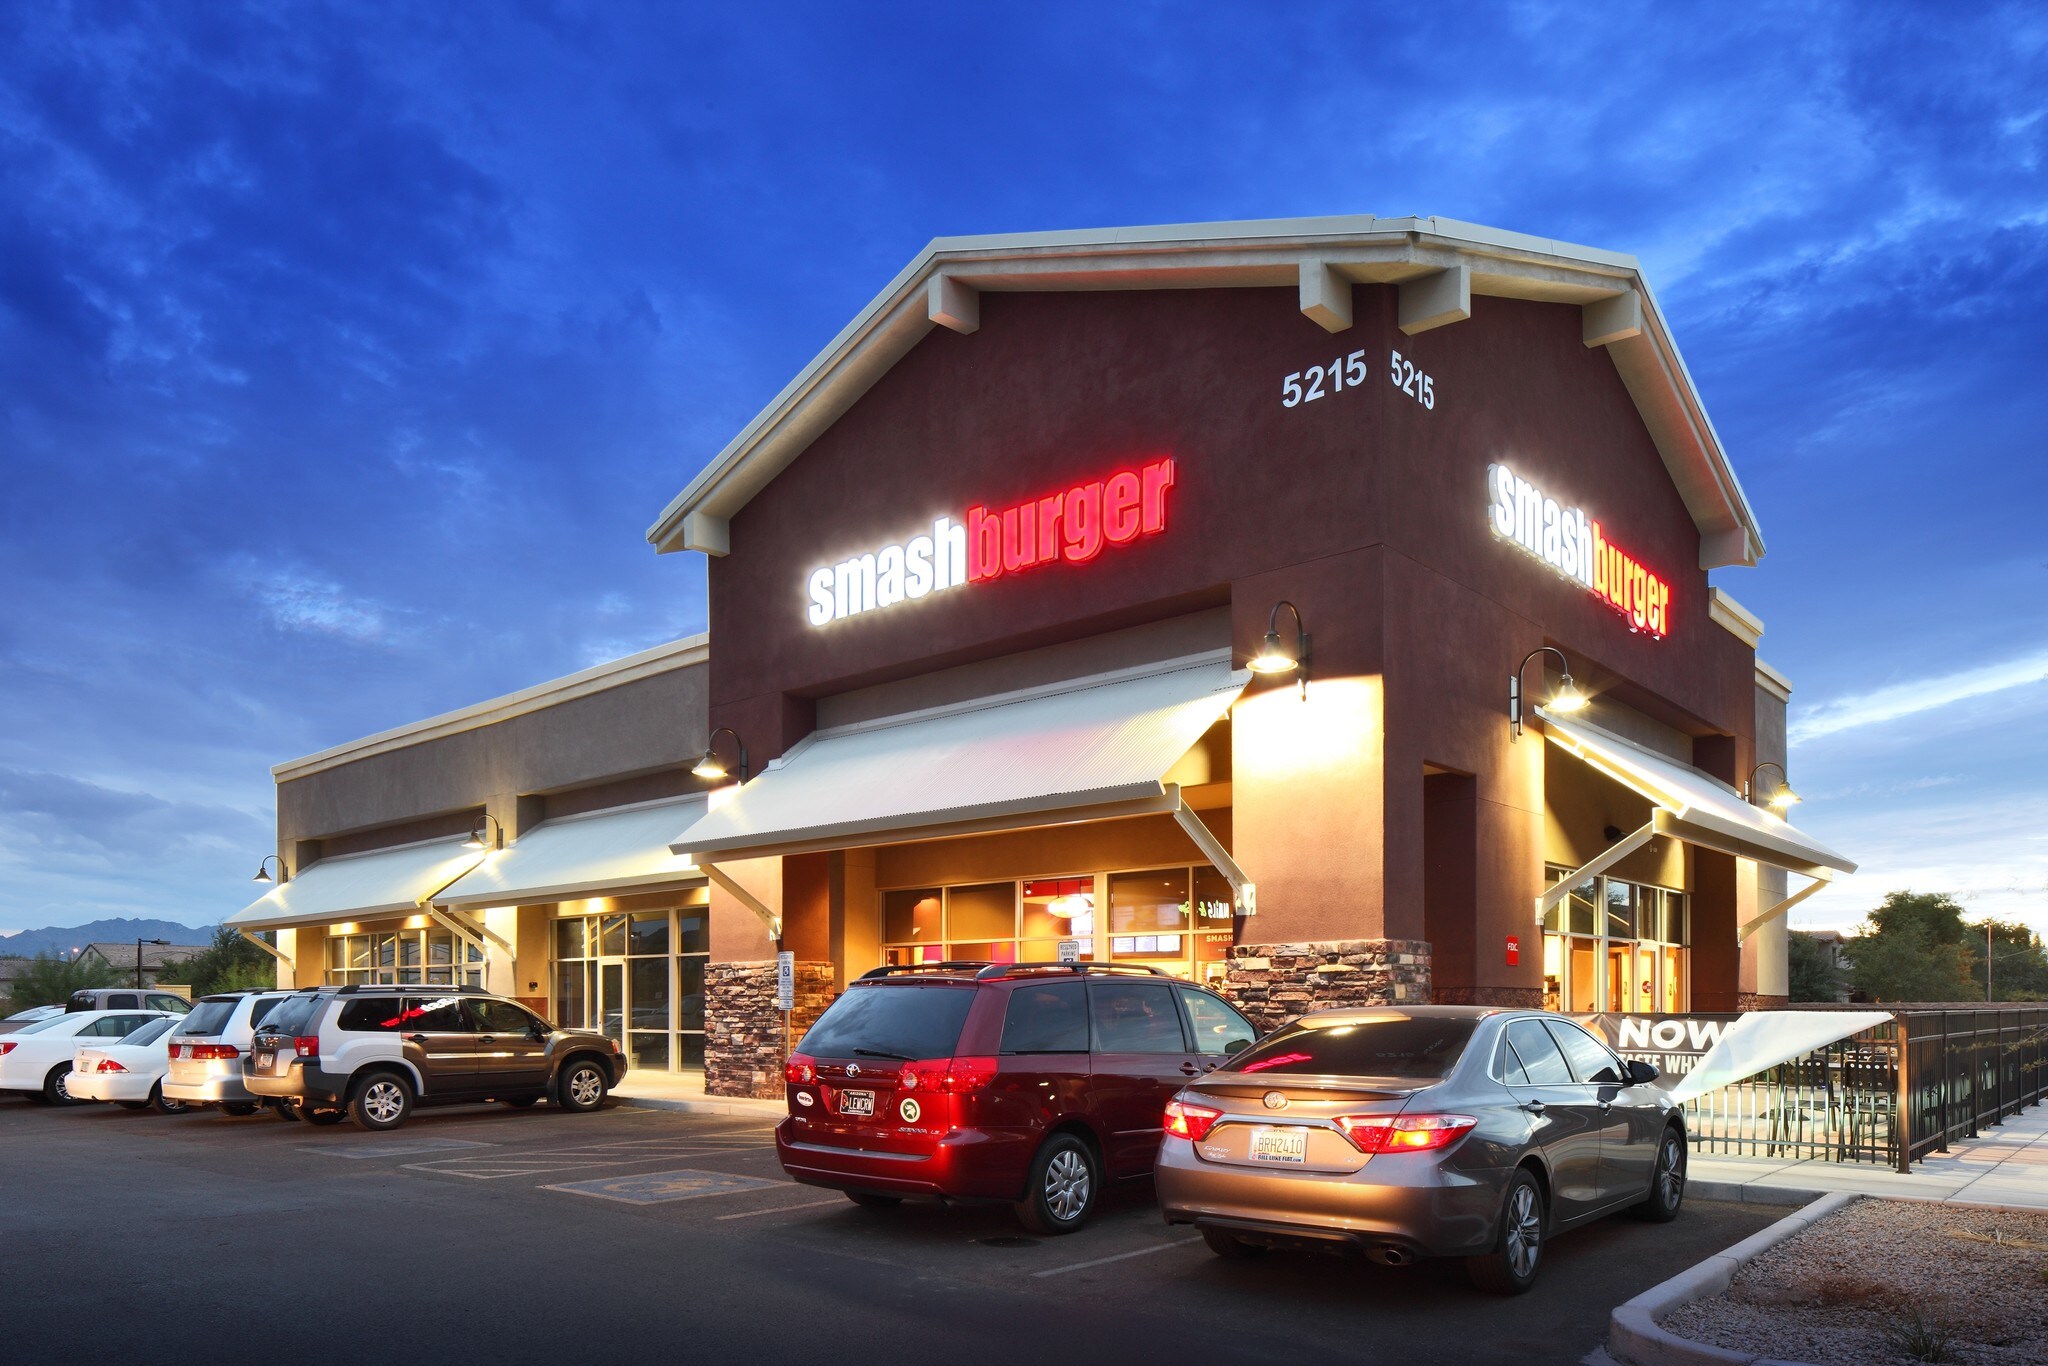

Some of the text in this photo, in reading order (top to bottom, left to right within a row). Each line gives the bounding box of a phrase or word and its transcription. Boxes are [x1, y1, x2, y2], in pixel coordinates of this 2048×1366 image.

[1282, 349, 1367, 409] 5215
[1391, 350, 1435, 410] 5215
[808, 458, 1176, 627] smashburger
[1488, 463, 1669, 638] smashburger
[1258, 1137, 1303, 1154] BRH2410
